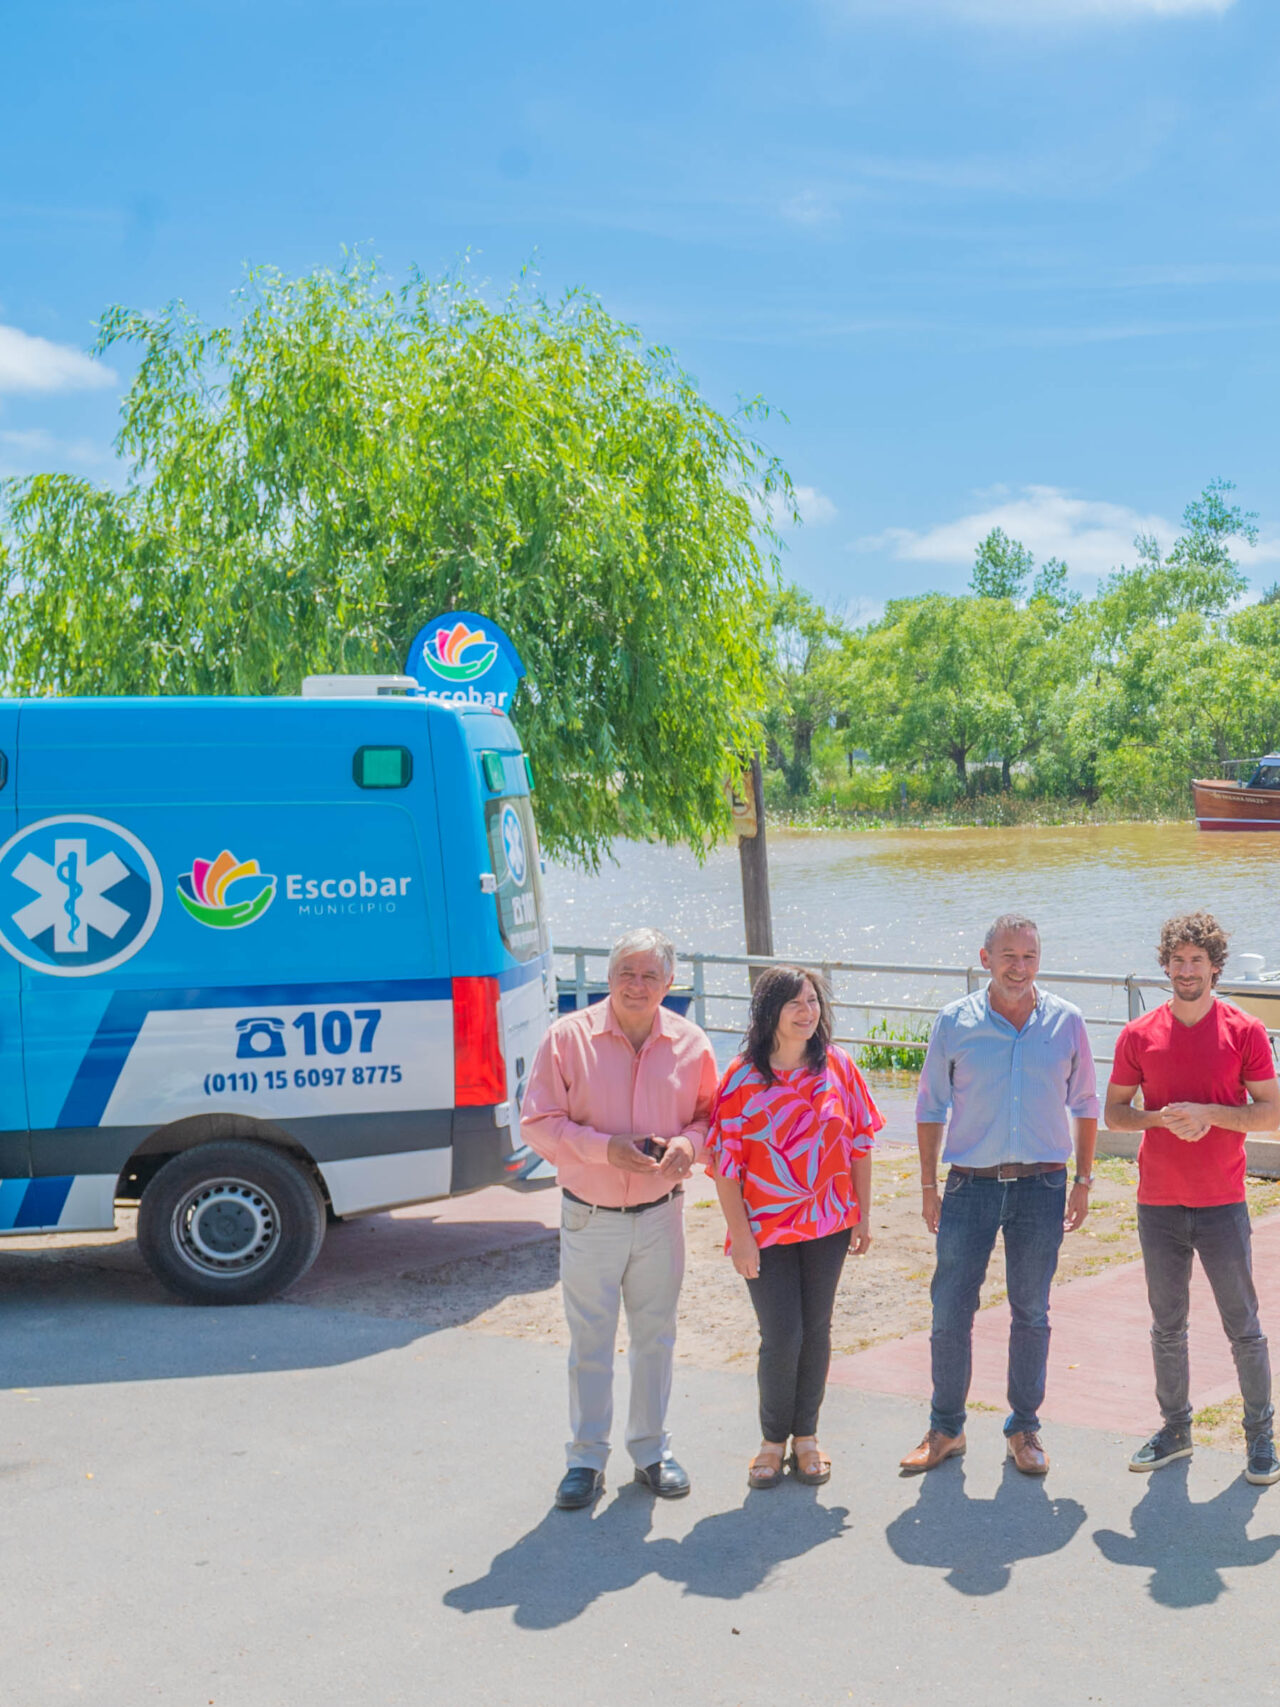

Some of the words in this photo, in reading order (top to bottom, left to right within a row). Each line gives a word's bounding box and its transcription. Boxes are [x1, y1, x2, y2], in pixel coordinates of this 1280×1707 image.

[286, 871, 412, 900] Escobar
[298, 902, 396, 915] MUNICIPIO
[292, 1009, 382, 1056] 107
[204, 1071, 258, 1095] (011)
[264, 1070, 288, 1090] 15
[294, 1068, 346, 1088] 6097
[352, 1065, 402, 1085] 8775
